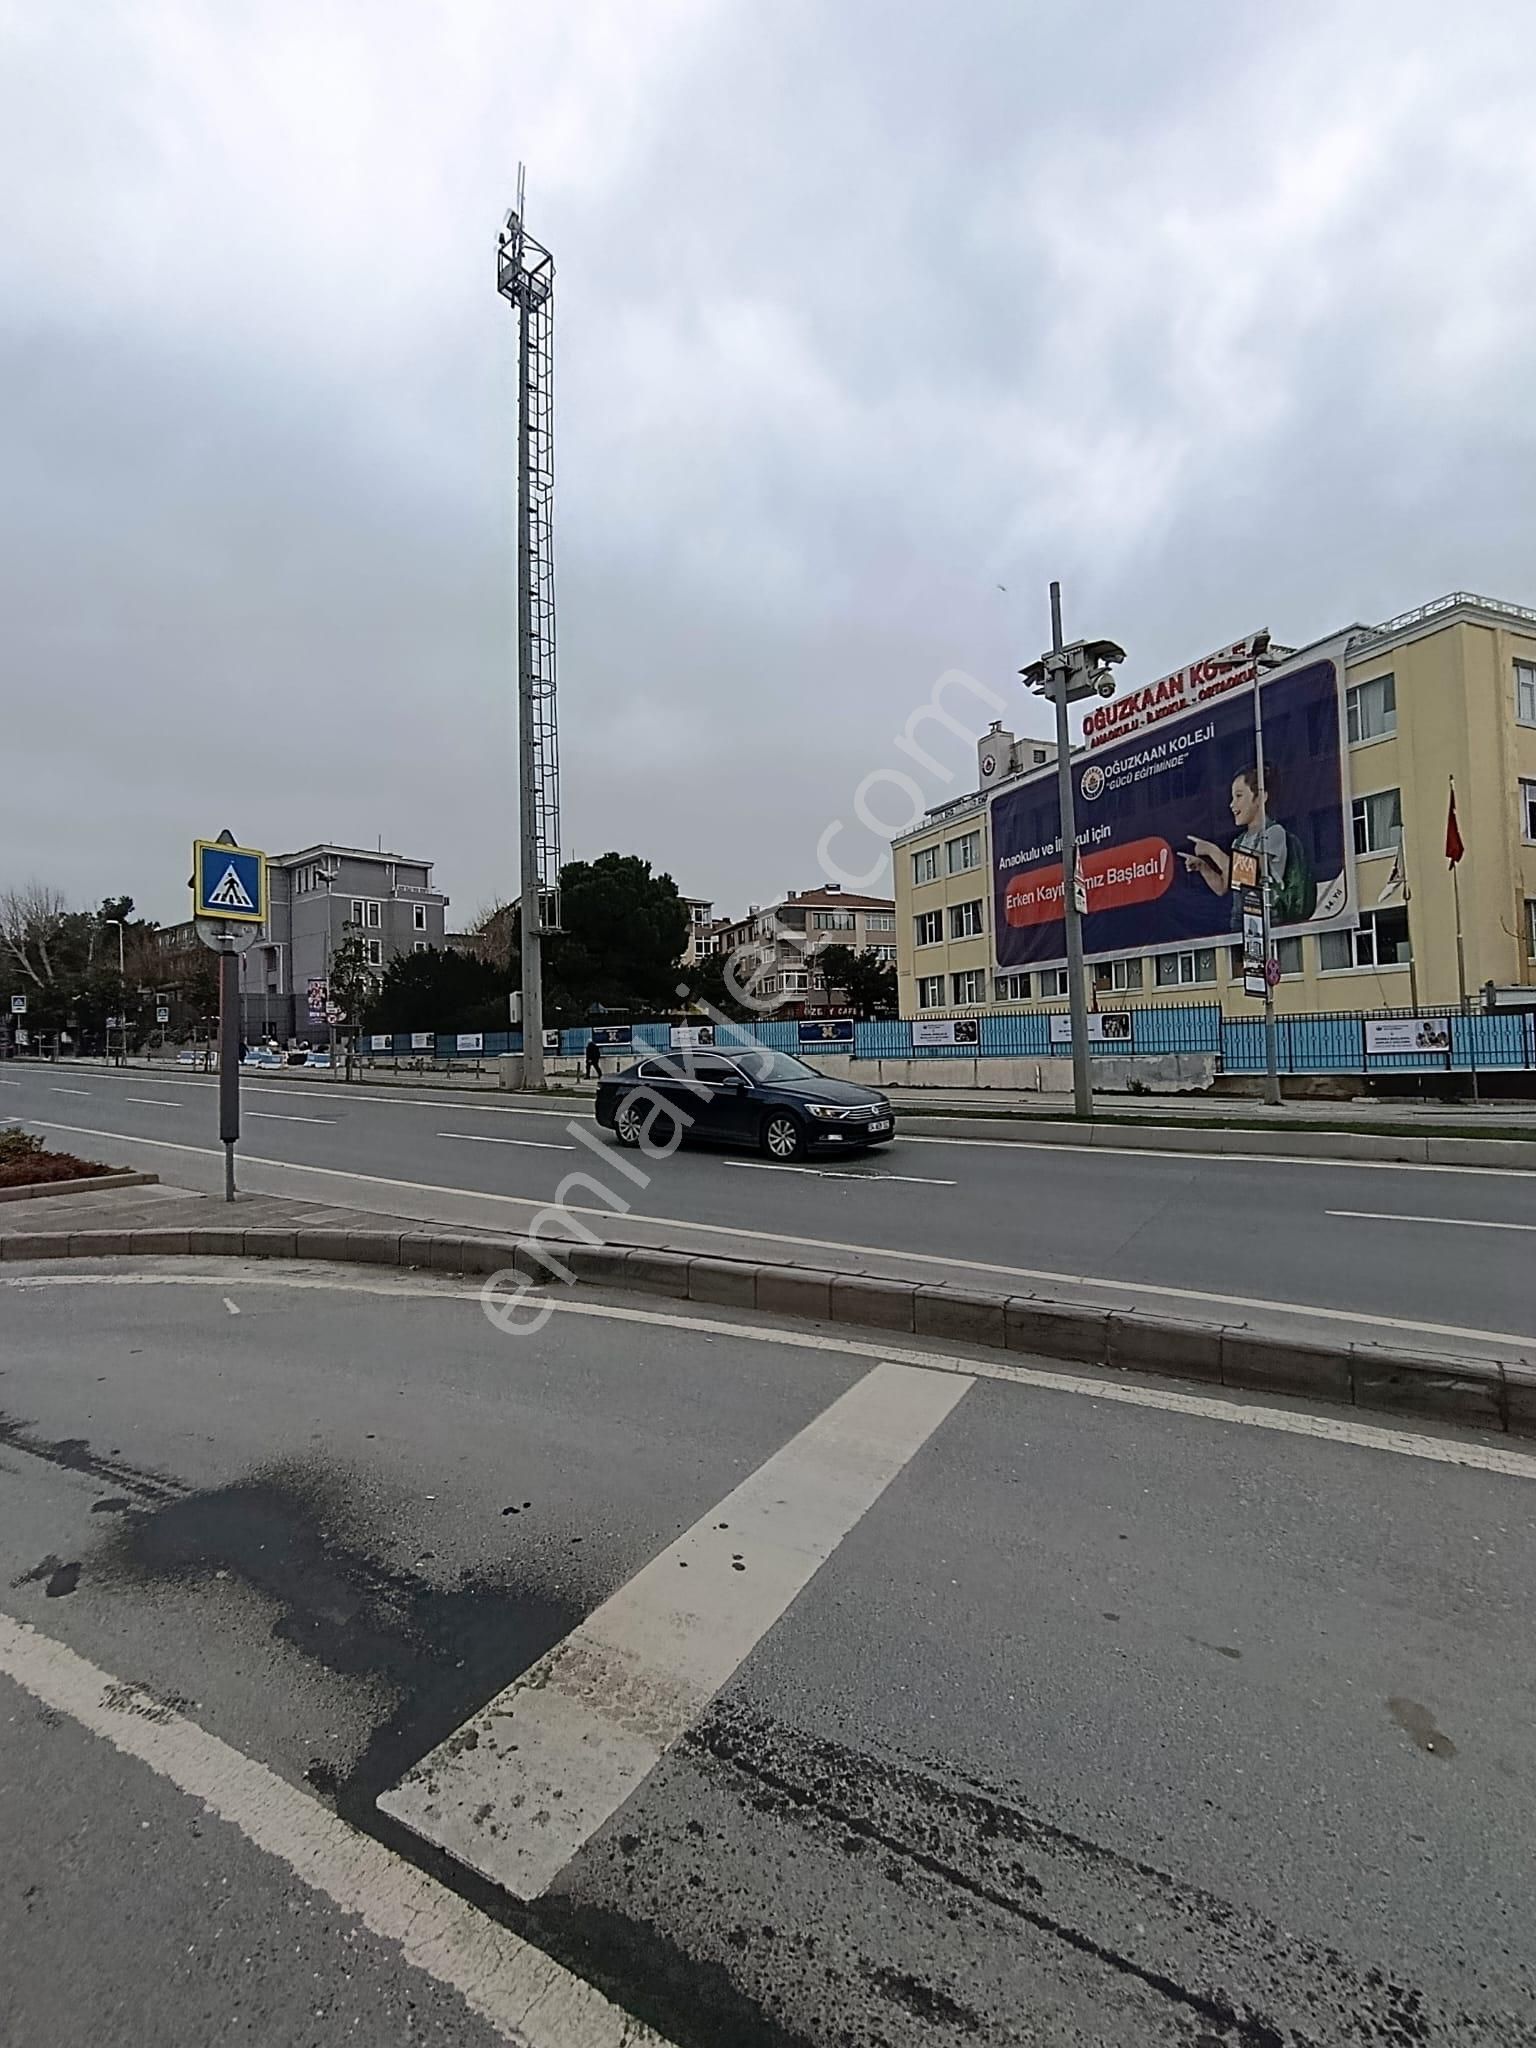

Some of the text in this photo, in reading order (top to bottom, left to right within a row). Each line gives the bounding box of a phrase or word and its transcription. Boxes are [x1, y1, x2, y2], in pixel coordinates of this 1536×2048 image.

[1083, 673, 1184, 736] OĞUZKAAN
[1104, 721, 1215, 778] OĞUZKAAN KOLEJİ
[999, 846, 1040, 870] Anaokulu
[1041, 843, 1054, 856] ve
[1091, 824, 1111, 844] için
[1006, 887, 1035, 910] Erken
